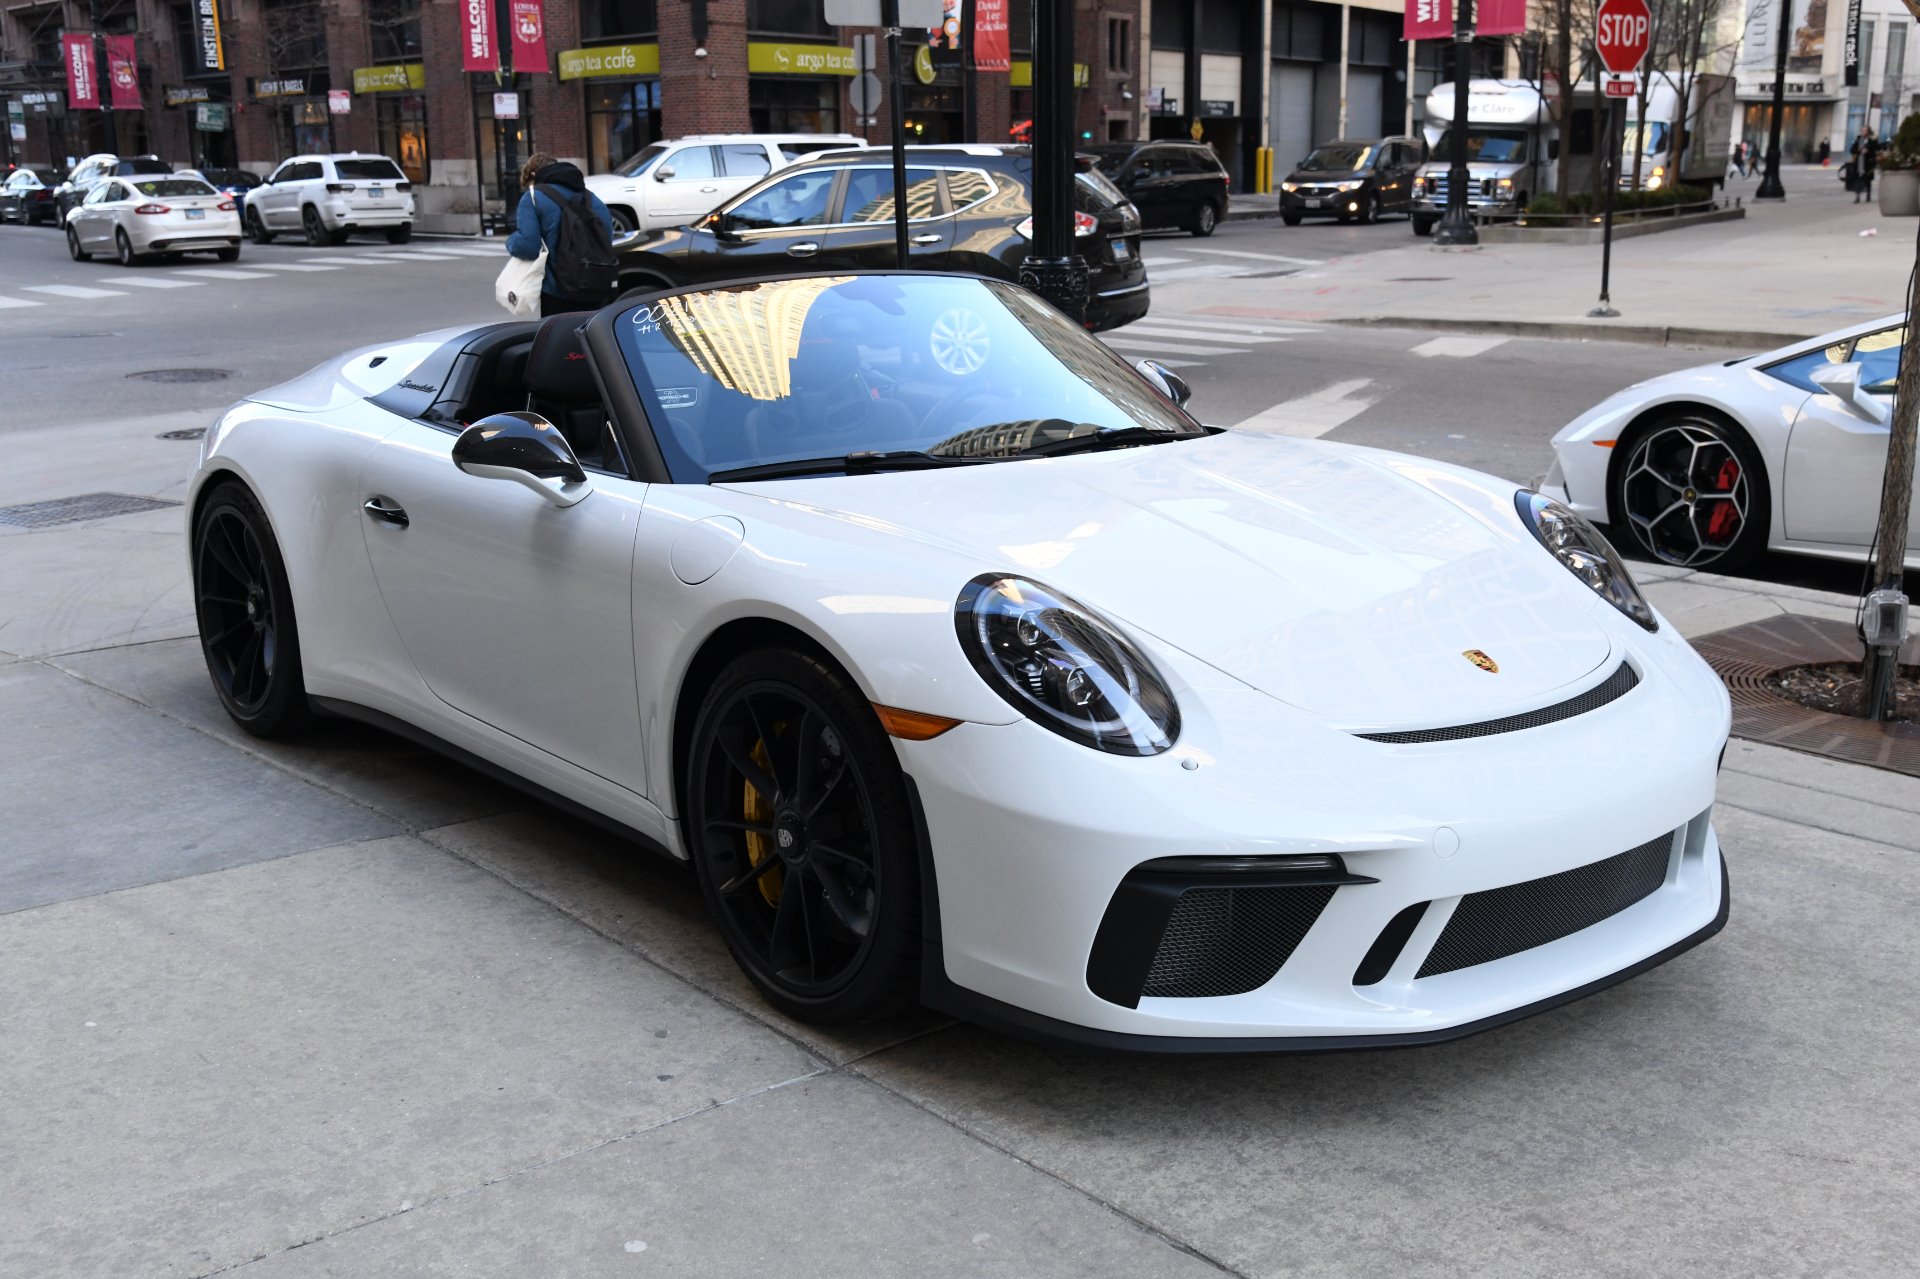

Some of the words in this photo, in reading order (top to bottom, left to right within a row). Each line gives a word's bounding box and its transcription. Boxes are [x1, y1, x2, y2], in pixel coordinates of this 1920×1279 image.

[201, 17, 219, 68] EINSTEIN
[468, 0, 483, 58] WELCO
[1600, 13, 1648, 47] STOP
[71, 43, 86, 100] WELCOME
[605, 47, 636, 69] café
[796, 53, 825, 72] argo
[827, 53, 841, 68] tea
[1608, 83, 1620, 94] ALL
[1620, 83, 1633, 94] WAY
